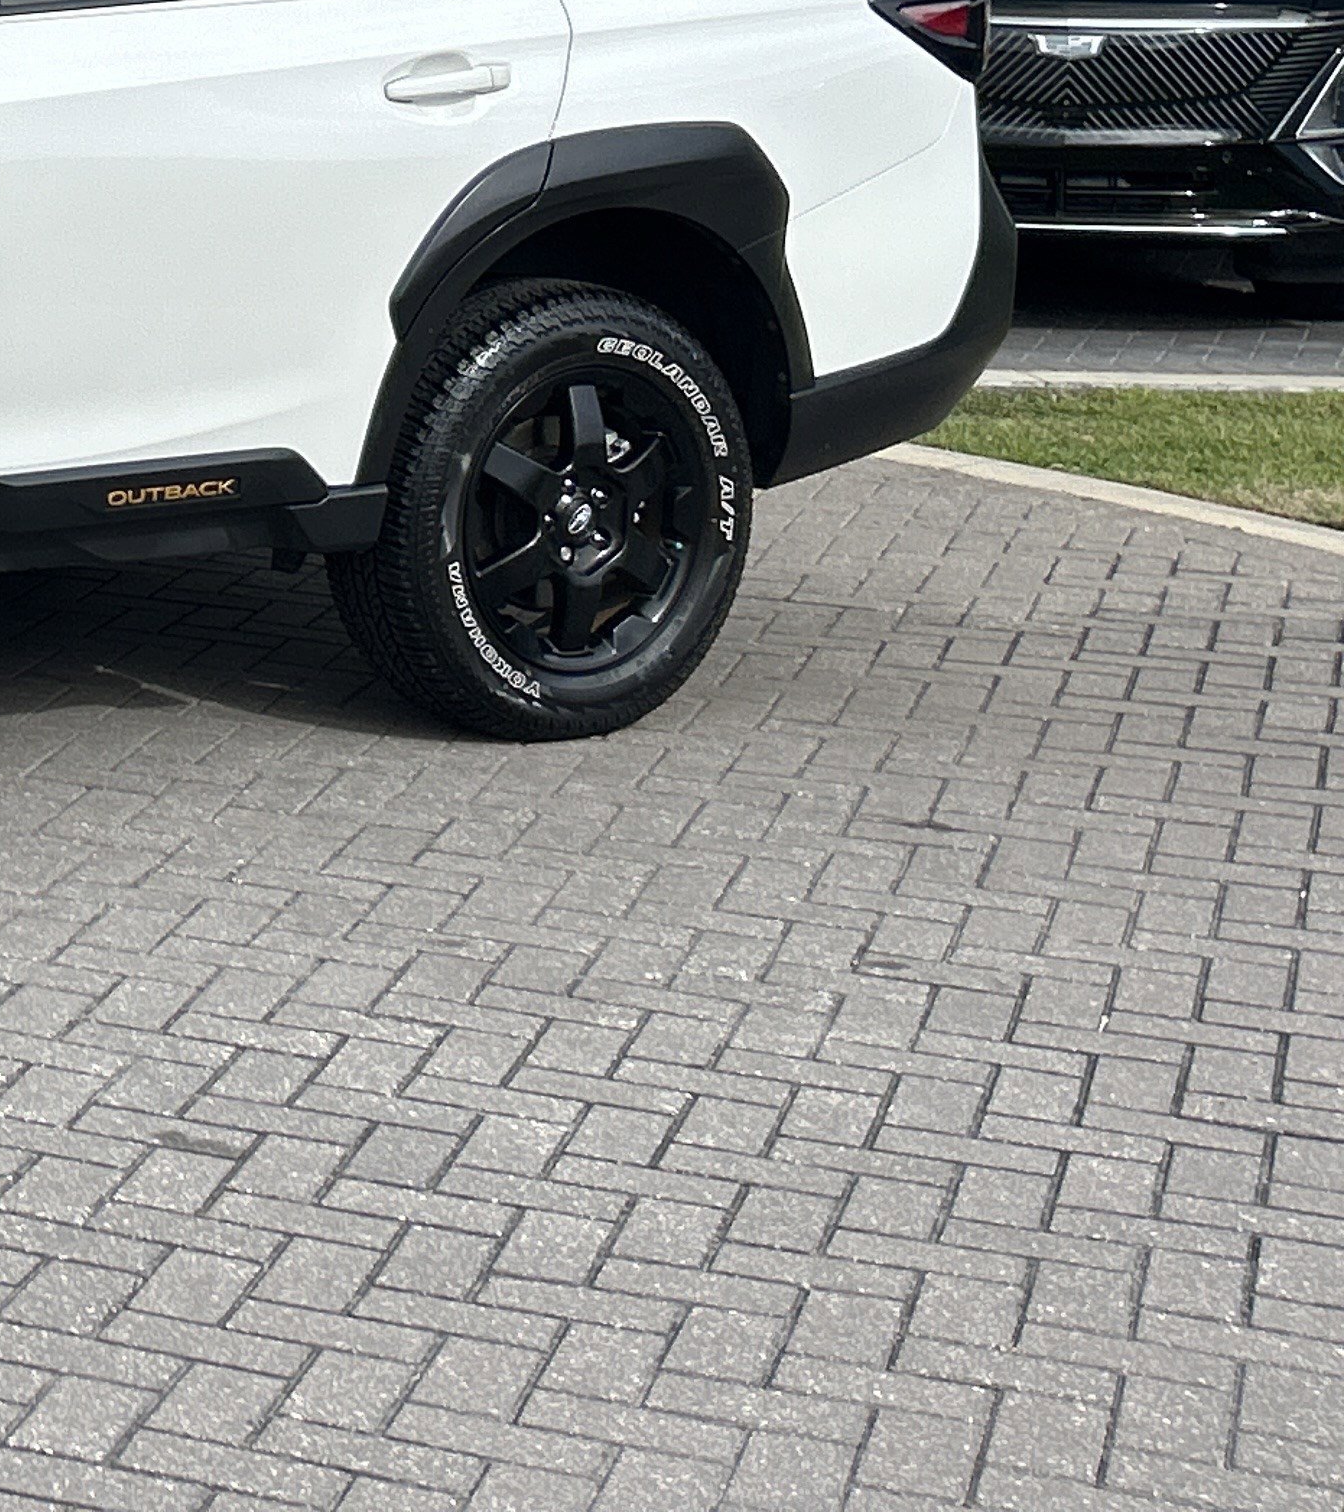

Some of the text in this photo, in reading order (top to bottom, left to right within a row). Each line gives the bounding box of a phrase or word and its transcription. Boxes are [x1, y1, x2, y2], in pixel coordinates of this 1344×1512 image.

[107, 478, 237, 507] OUTBACK
[597, 337, 736, 541] GEOLANDAR A/T
[447, 560, 542, 699] YOKOHAMA
